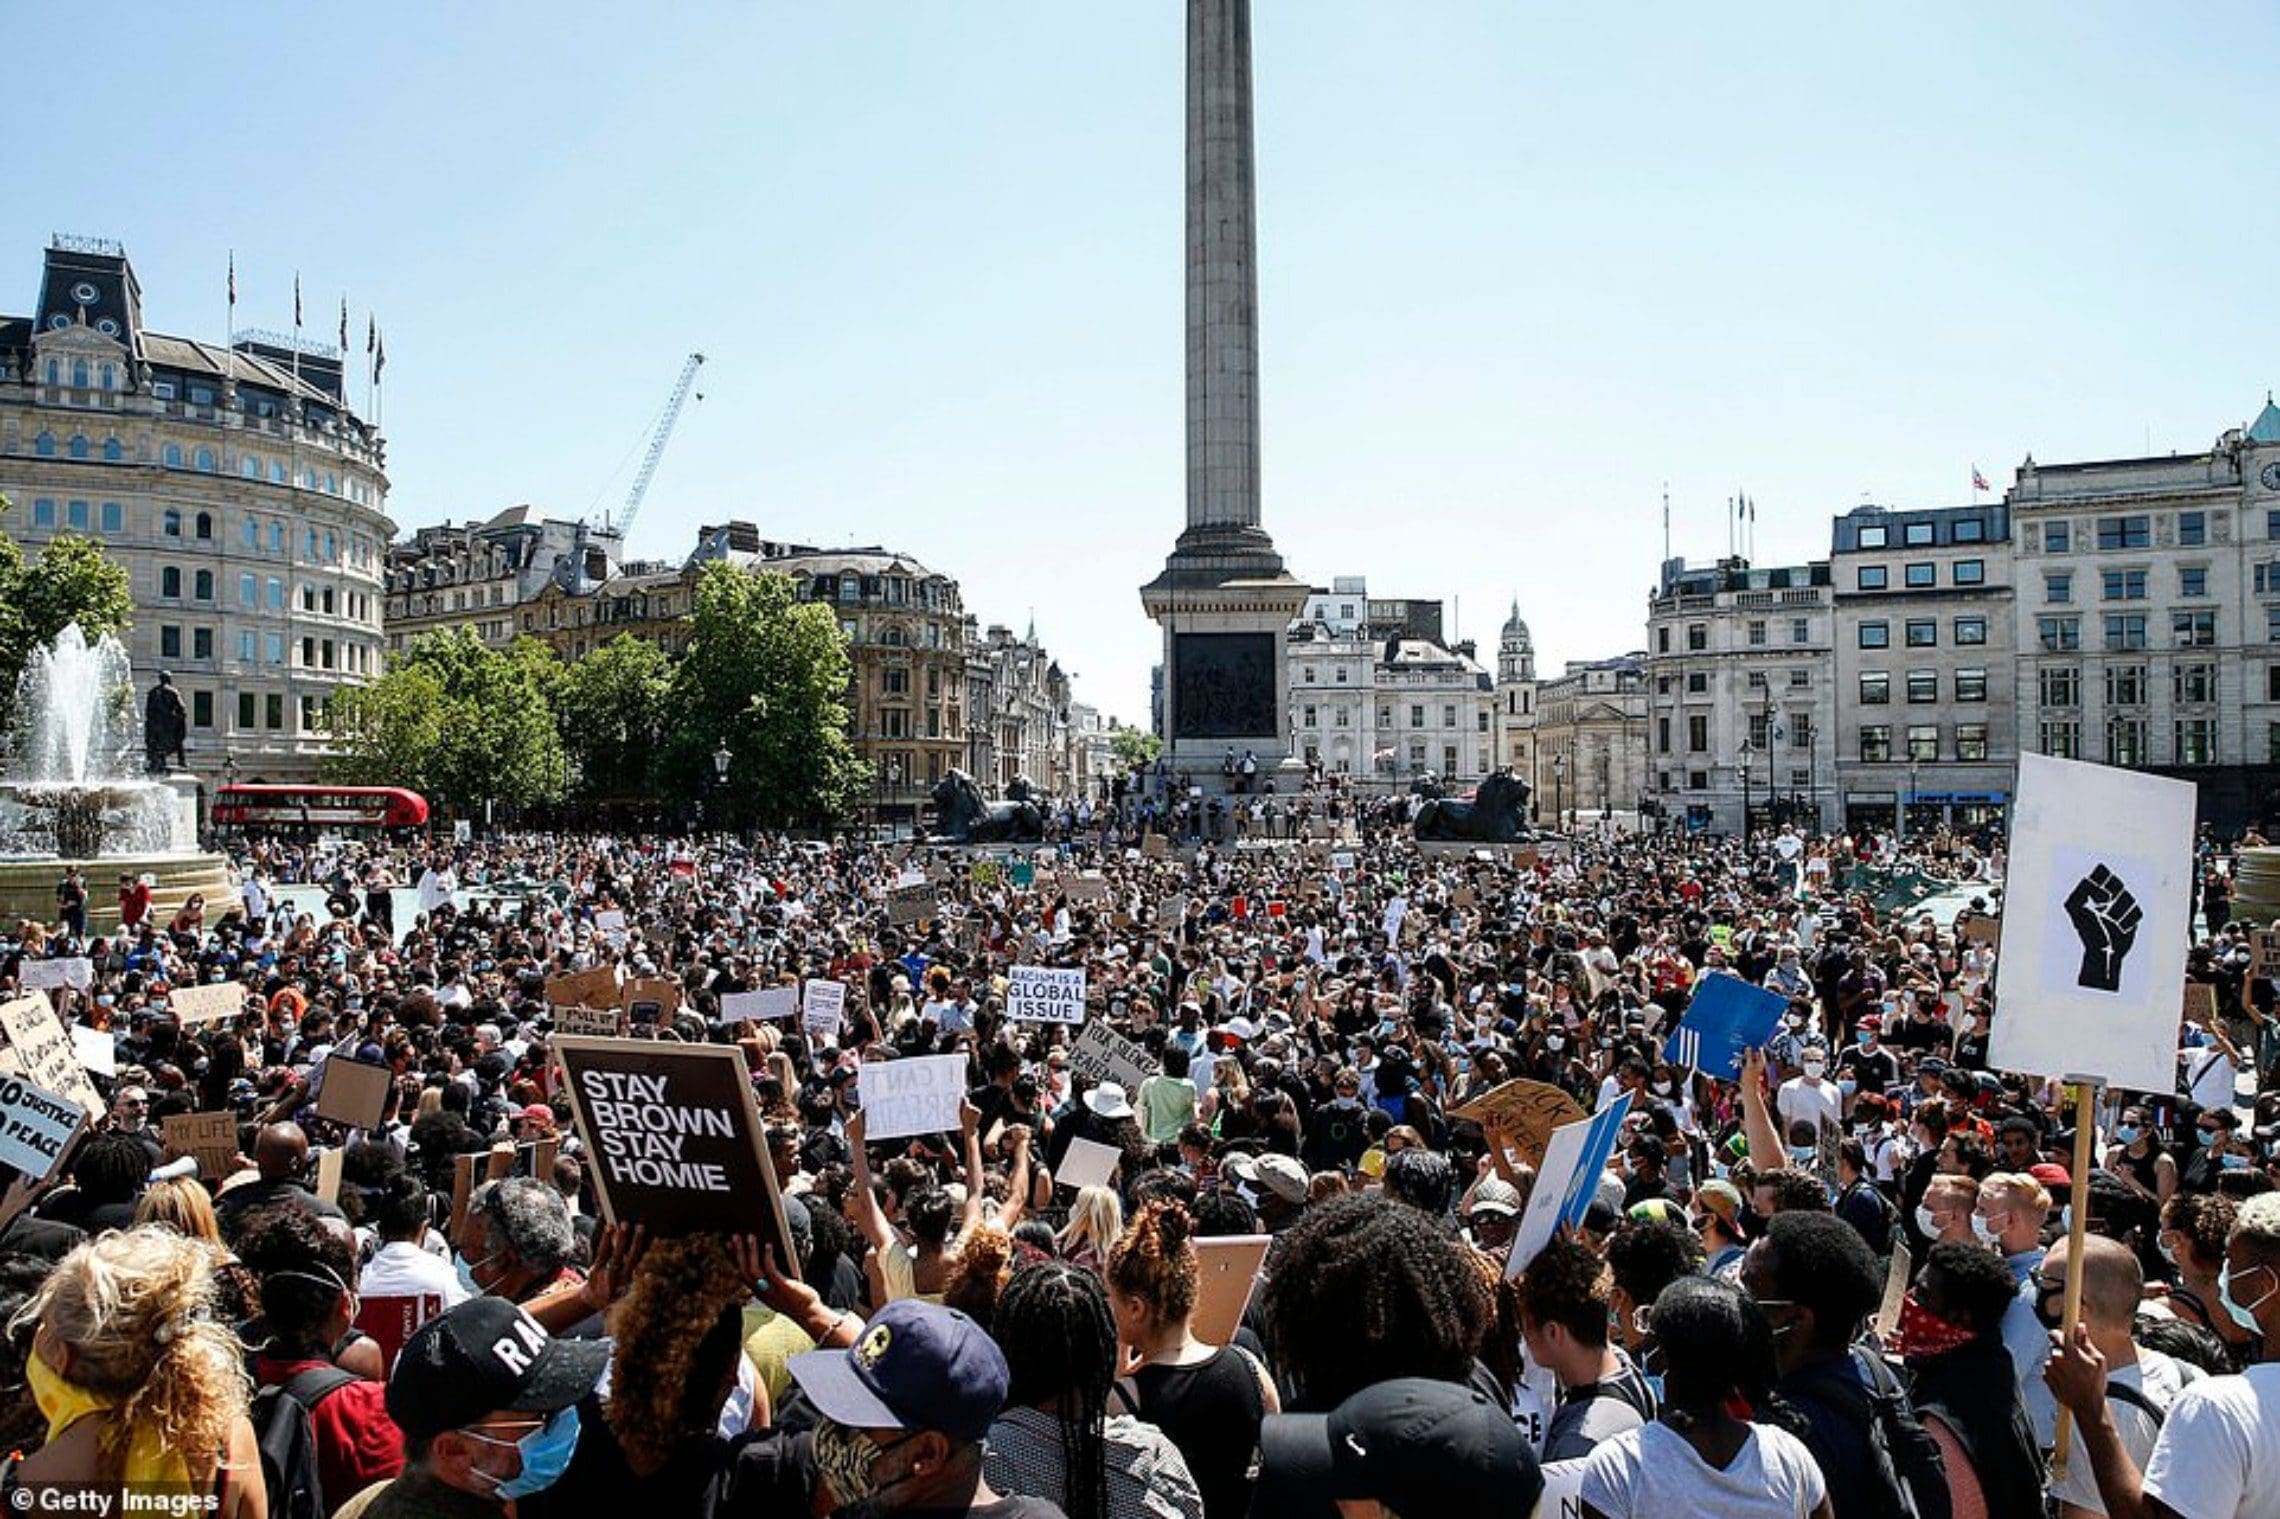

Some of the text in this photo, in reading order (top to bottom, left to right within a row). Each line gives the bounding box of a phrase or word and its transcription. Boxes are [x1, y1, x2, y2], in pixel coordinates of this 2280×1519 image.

[1009, 982, 1085, 1001] GLOBAL
[1011, 969, 1082, 985] RACISM IS A
[1016, 1001, 1073, 1020] ISSUE
[582, 1069, 668, 1104] STAY
[21, 1092, 79, 1129] JUSTICE
[590, 1100, 736, 1139] BROWN
[6, 1120, 62, 1158] PEACE
[170, 1118, 235, 1141] MY LIFE
[600, 1129, 685, 1162] STAY
[608, 1155, 731, 1192] HOMIE
